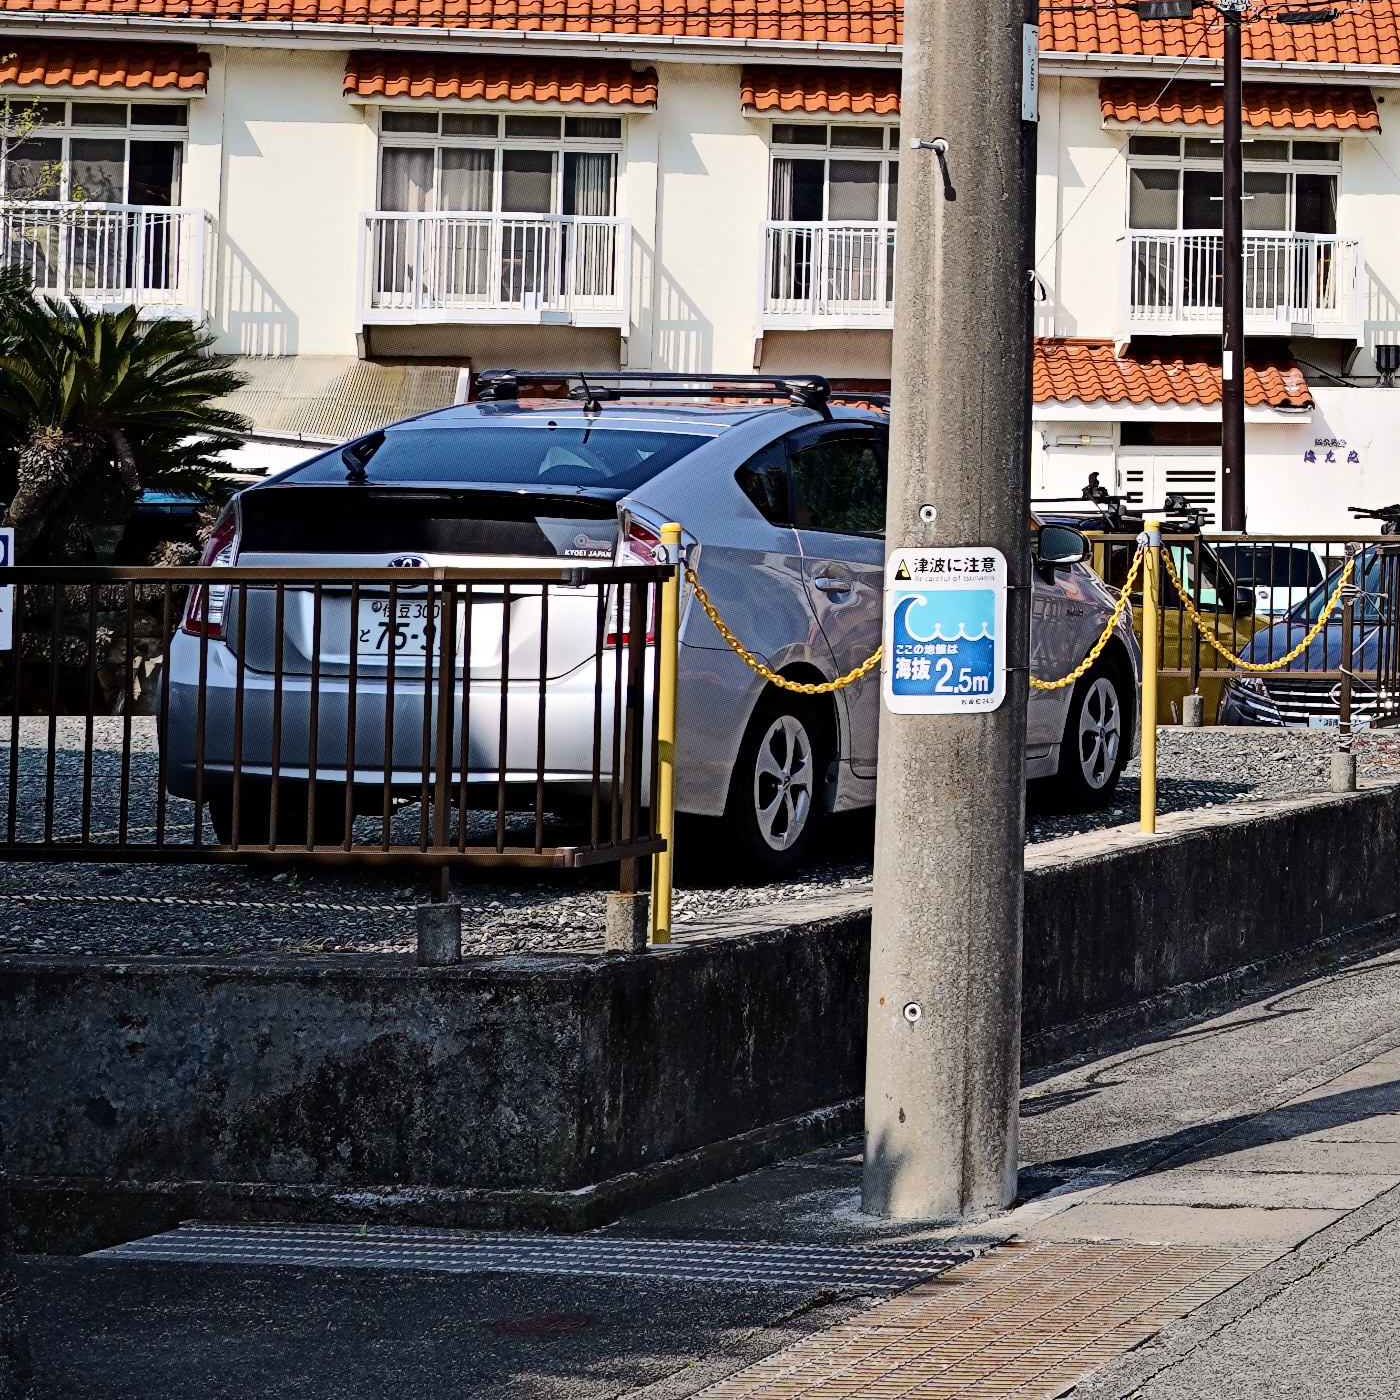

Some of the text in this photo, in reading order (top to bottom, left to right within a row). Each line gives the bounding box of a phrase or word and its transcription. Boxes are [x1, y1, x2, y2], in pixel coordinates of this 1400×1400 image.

[564, 548, 612, 558] KYOEI JAPAN
[914, 557, 996, 573] 津波に注意
[925, 574, 951, 582] careful
[953, 574, 961, 582] of
[963, 574, 996, 582] tsunamis
[359, 628, 371, 643] と
[895, 643, 959, 655] ここの地盤は
[895, 657, 989, 693] 海抜 2.5m
